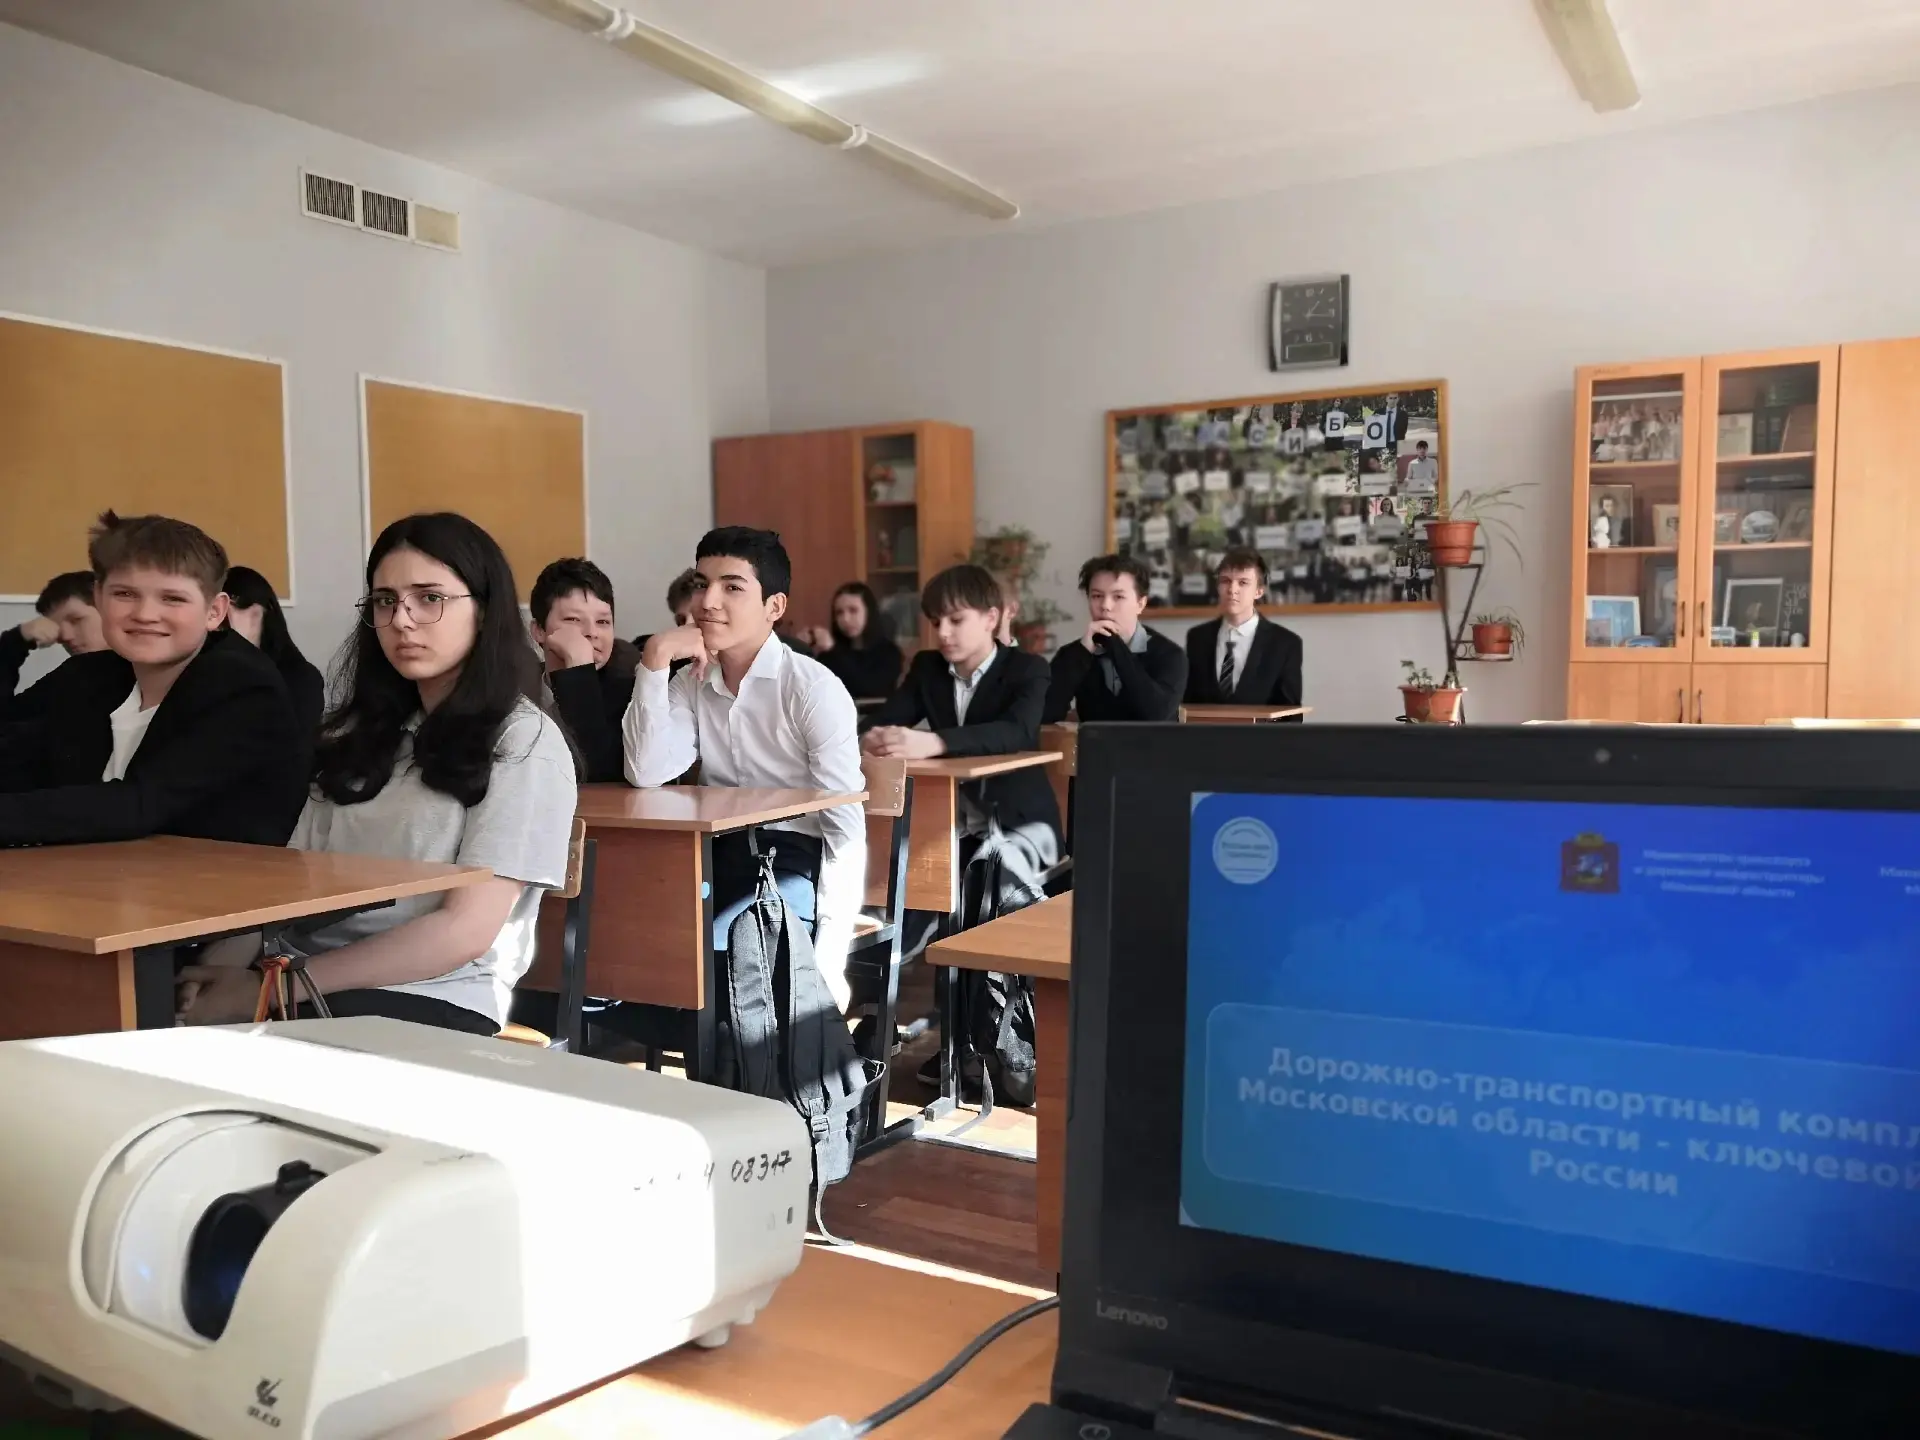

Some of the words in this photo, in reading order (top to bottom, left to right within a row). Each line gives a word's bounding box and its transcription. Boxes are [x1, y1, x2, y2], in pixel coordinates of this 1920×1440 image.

[1329, 418, 1341, 432] Б
[1366, 422, 1384, 440] О
[1238, 1077, 1459, 1128] Московской
[1472, 1107, 1641, 1153] области
[1268, 1047, 1760, 1130] Дорожно-транспортный
[1530, 1148, 1679, 1198] России
